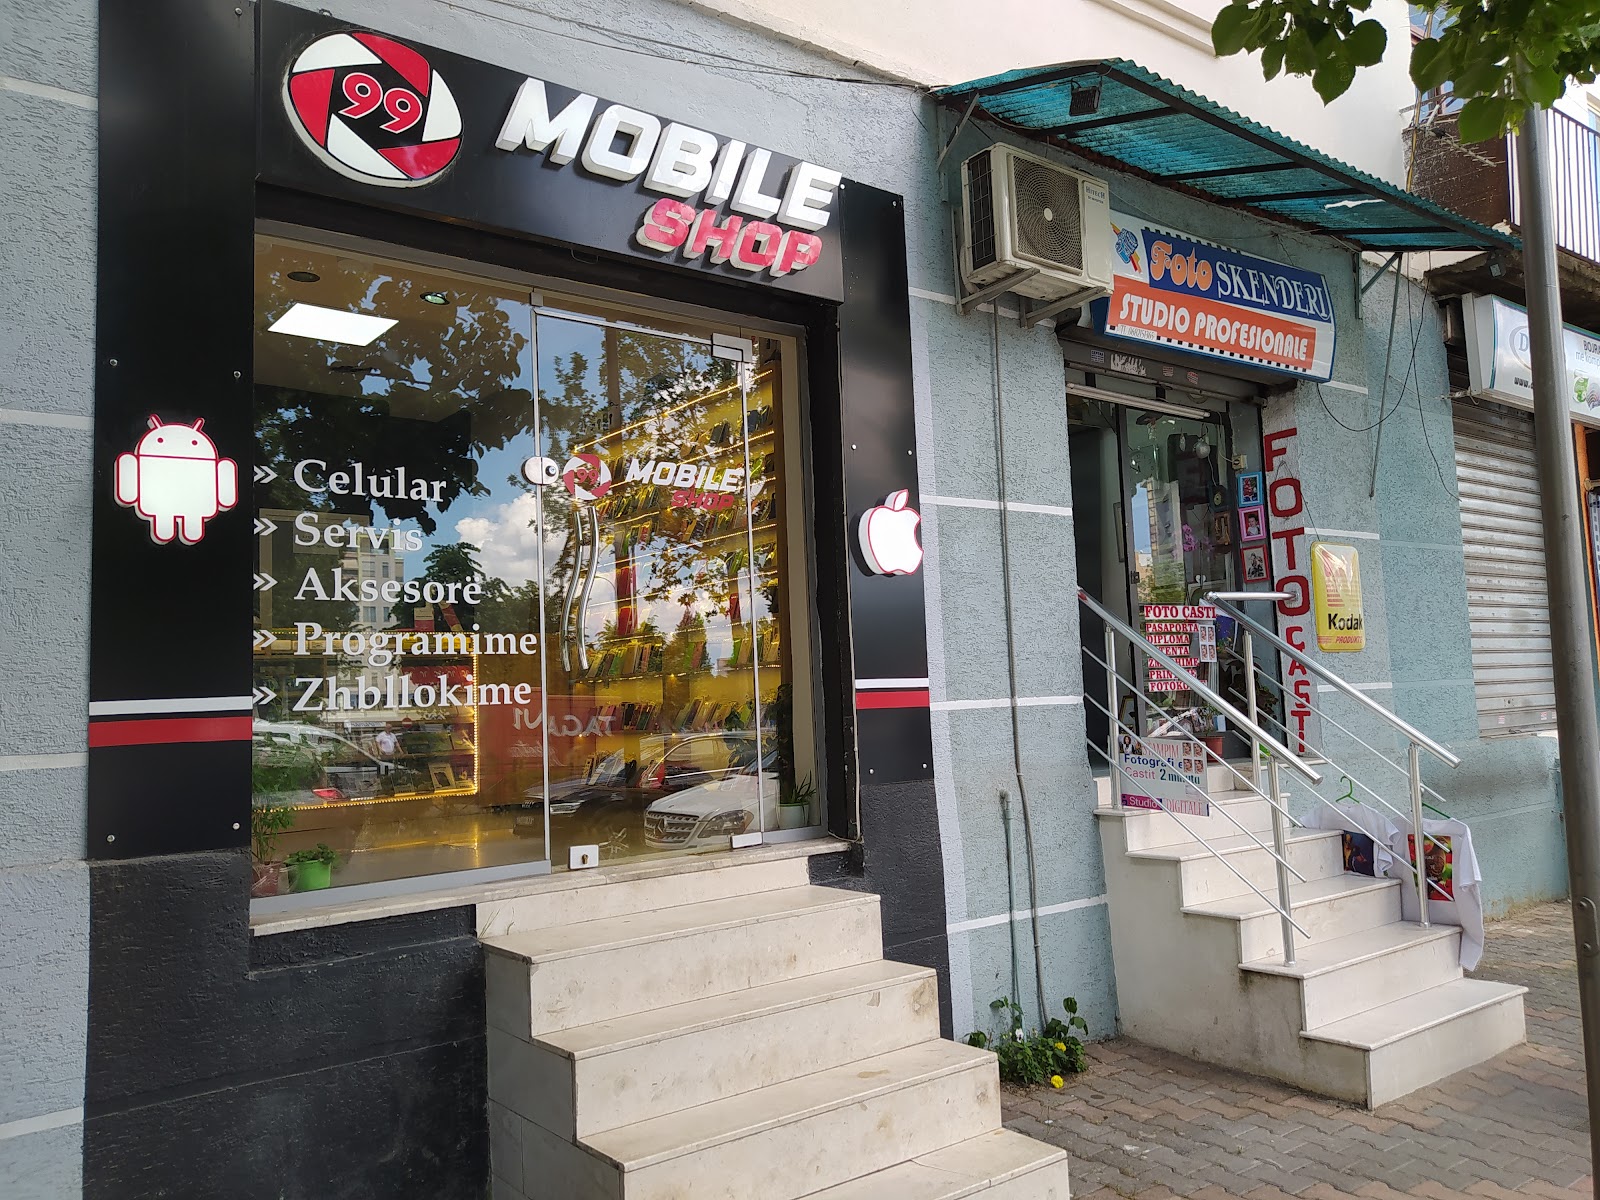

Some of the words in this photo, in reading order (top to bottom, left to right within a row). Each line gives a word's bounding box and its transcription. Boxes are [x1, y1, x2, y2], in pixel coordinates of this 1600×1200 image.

[342, 72, 422, 134] 99
[496, 77, 842, 231] MOBILE
[636, 197, 822, 277] SHOP
[1150, 241, 1213, 291] Foto
[1119, 293, 1190, 334] STUDIO
[1194, 312, 1307, 360] PROFESIONALE
[1583, 340, 1600, 356] BOJRA
[294, 459, 447, 502] Celular
[625, 459, 744, 492] MOBILE
[671, 490, 735, 511] SHOP
[294, 512, 423, 551] Servis
[1264, 428, 1310, 616] FOTO
[294, 567, 482, 605] Aksesorë
[1144, 605, 1178, 618] FOTO
[1146, 623, 1199, 632] PASAPORTA
[1328, 613, 1363, 630] Kodak
[294, 623, 537, 667] Programime
[1147, 635, 1190, 644] DIPLOMA
[1156, 646, 1189, 656] TENTA
[1149, 658, 1199, 667] ZMHIME
[292, 674, 532, 711] Zhbllokime
[1124, 754, 1174, 768] Fotografi
[1160, 768, 1167, 781] 2
[1129, 796, 1158, 809] Studio
